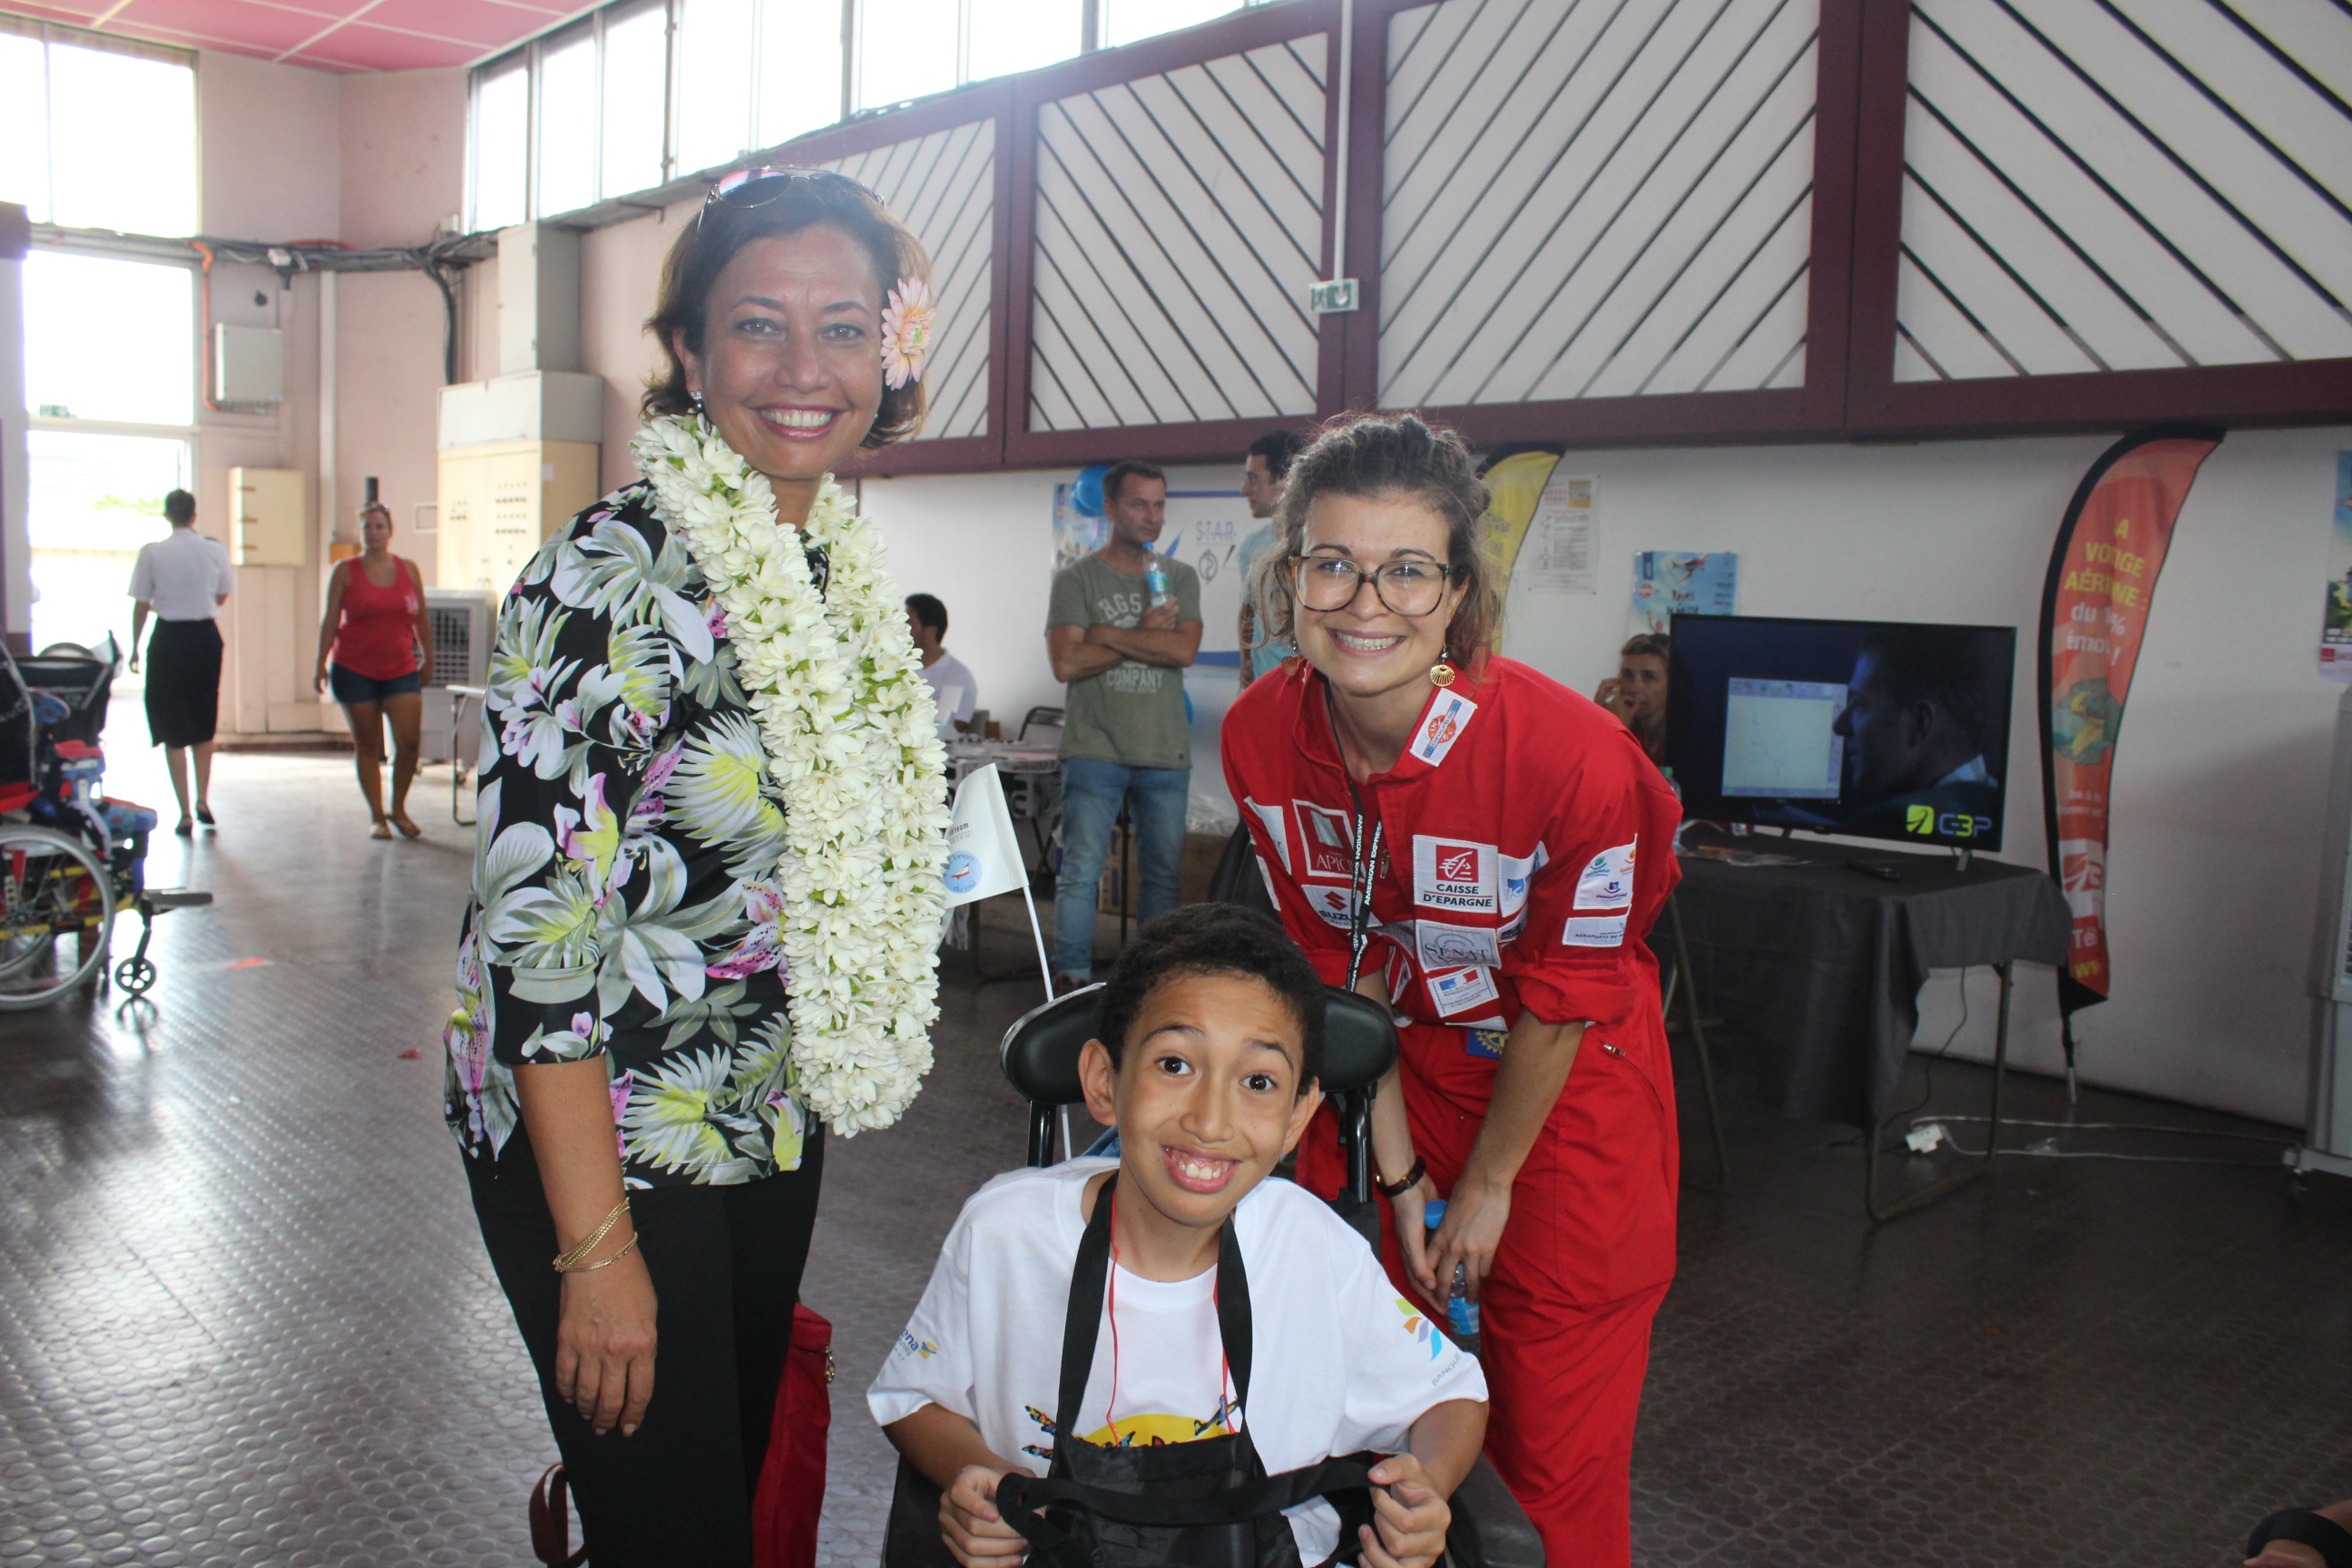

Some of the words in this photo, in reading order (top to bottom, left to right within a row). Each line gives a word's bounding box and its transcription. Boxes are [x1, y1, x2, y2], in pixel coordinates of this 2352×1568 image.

[1107, 668, 1164, 689] COMPANY
[1355, 814, 1363, 860] AMERICAN
[1364, 859, 1376, 906] AMERICAN
[1436, 883, 1480, 895] CAISSE
[1423, 893, 1493, 907] D'EPARGNE
[1425, 943, 1490, 961] SÉNAT
[902, 1328, 918, 1352] ena
[1431, 1351, 1463, 1387] BANQUE
